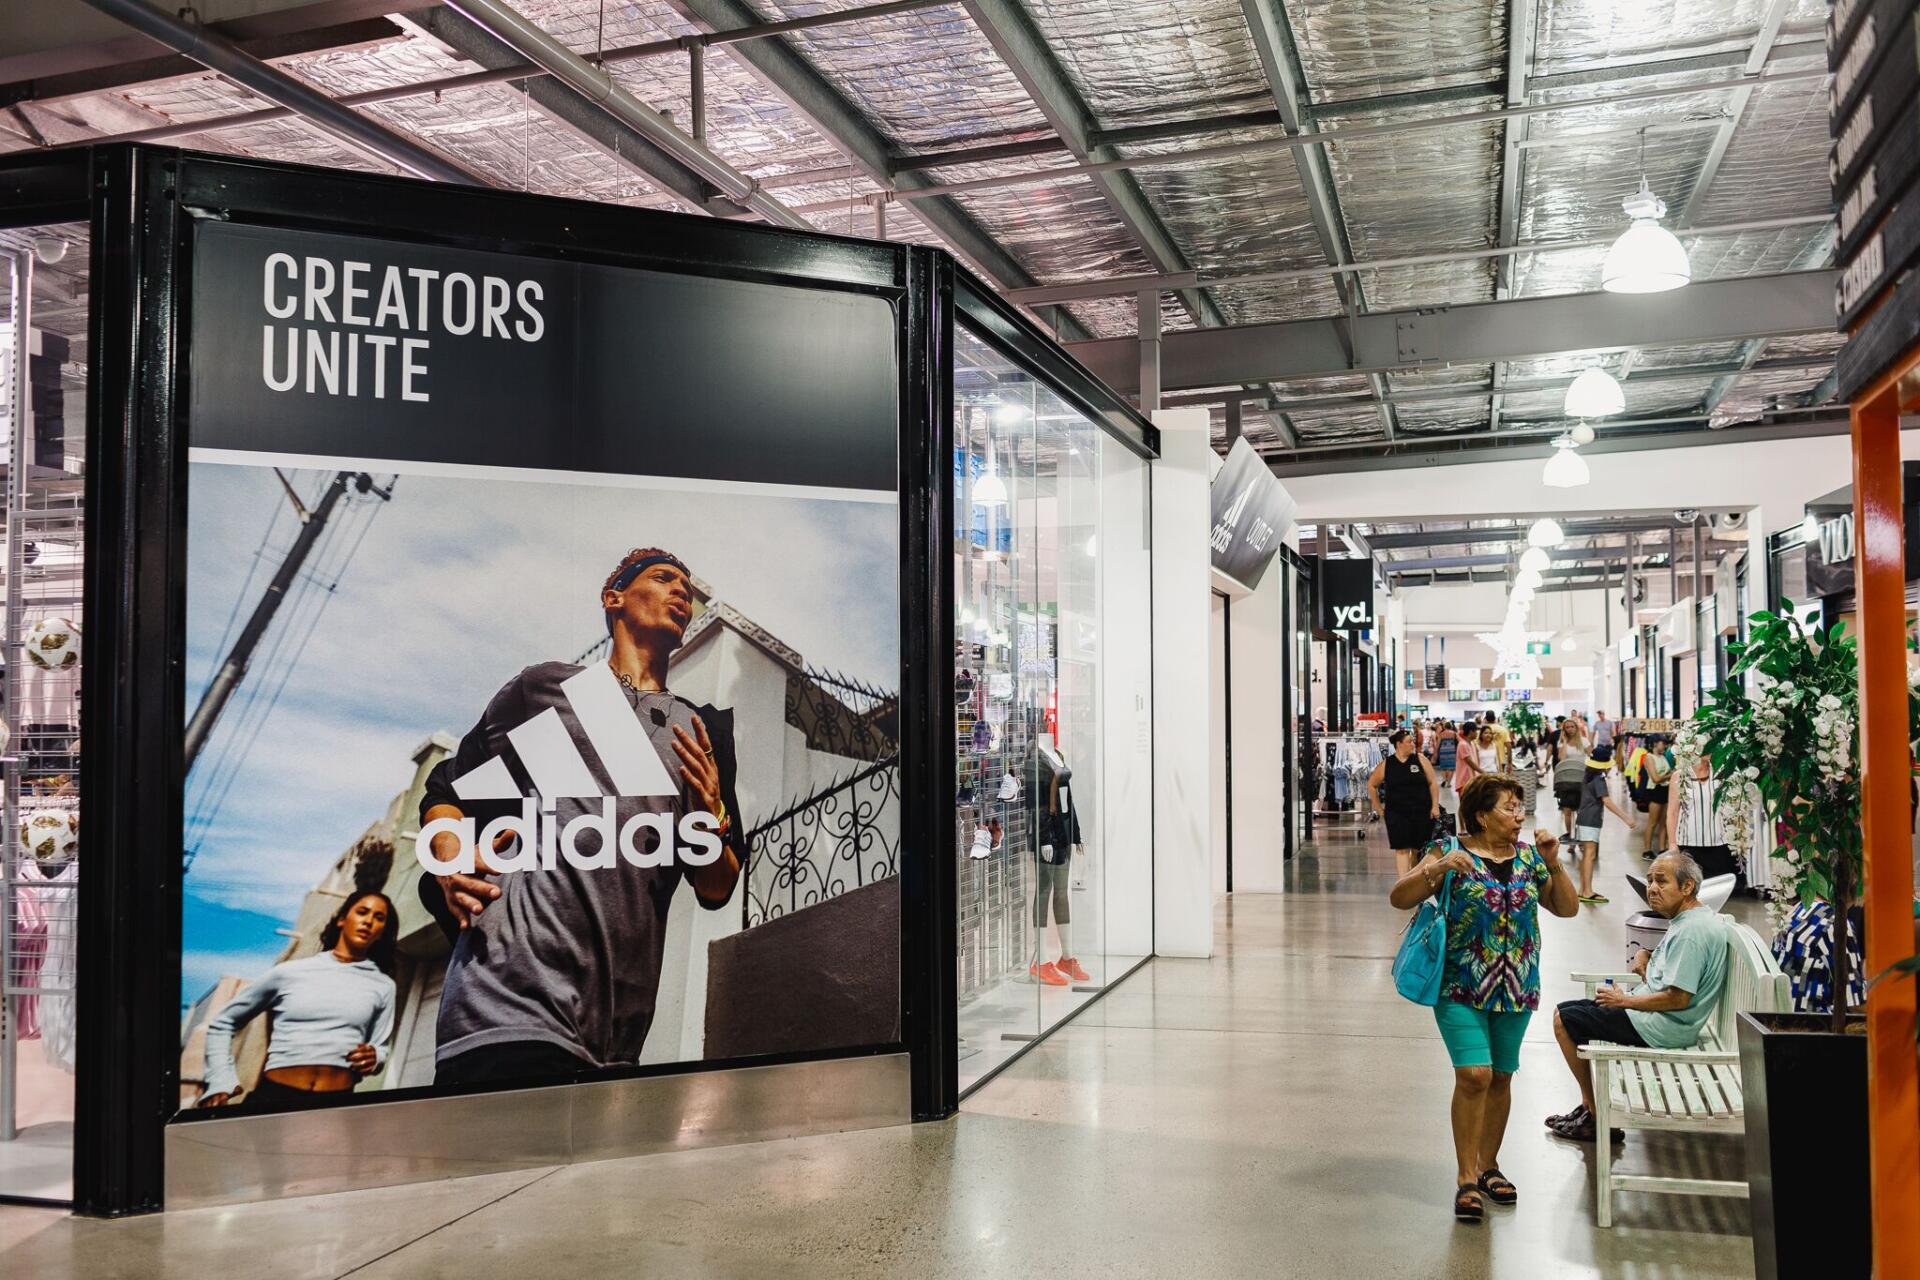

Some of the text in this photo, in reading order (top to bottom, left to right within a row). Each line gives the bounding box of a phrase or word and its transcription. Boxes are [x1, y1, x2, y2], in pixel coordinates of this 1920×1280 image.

[264, 252, 545, 342] CREATORS
[262, 325, 430, 402] UNITE
[1245, 516, 1274, 553] OUTLET
[1333, 601, 1372, 628] yd.
[1640, 721, 1647, 731] 2
[1648, 720, 1667, 732] FOR
[415, 796, 723, 877] adidas
